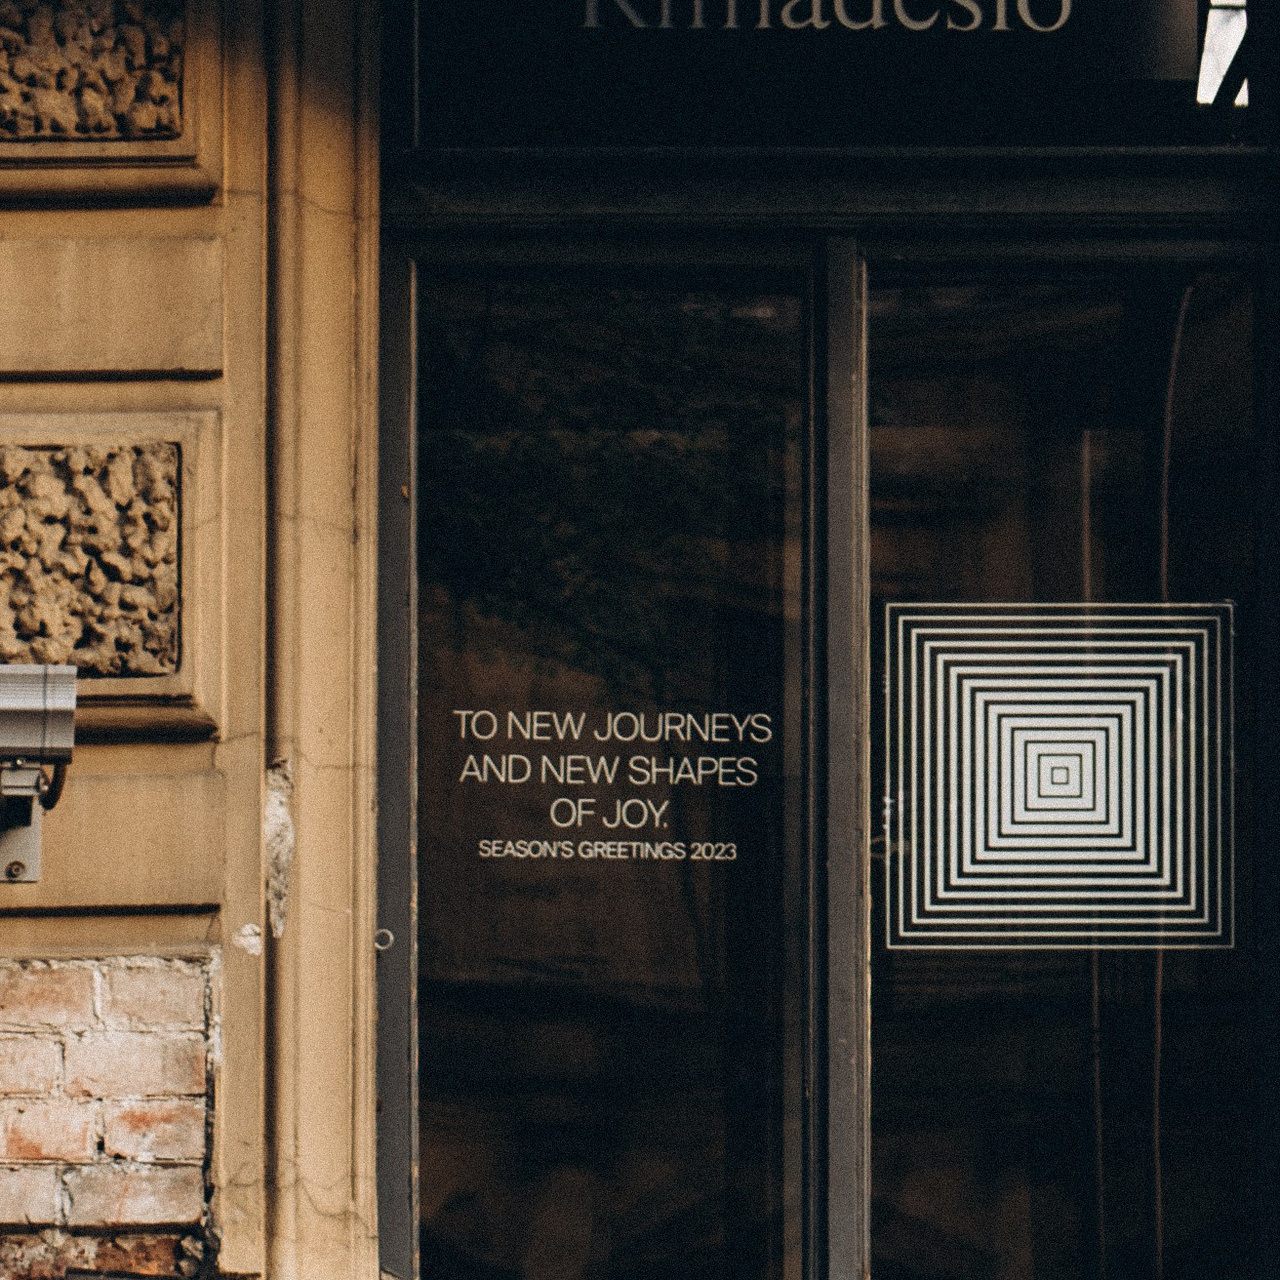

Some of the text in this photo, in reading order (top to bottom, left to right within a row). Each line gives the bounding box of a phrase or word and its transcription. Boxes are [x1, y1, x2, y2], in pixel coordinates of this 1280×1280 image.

[453, 709, 773, 743] TO NEW JOURNEYS
[459, 753, 758, 786] AND NEW SHAPES
[549, 798, 670, 829] OF JOY.
[479, 839, 737, 861] SEASON'S GREETINGS 2023
